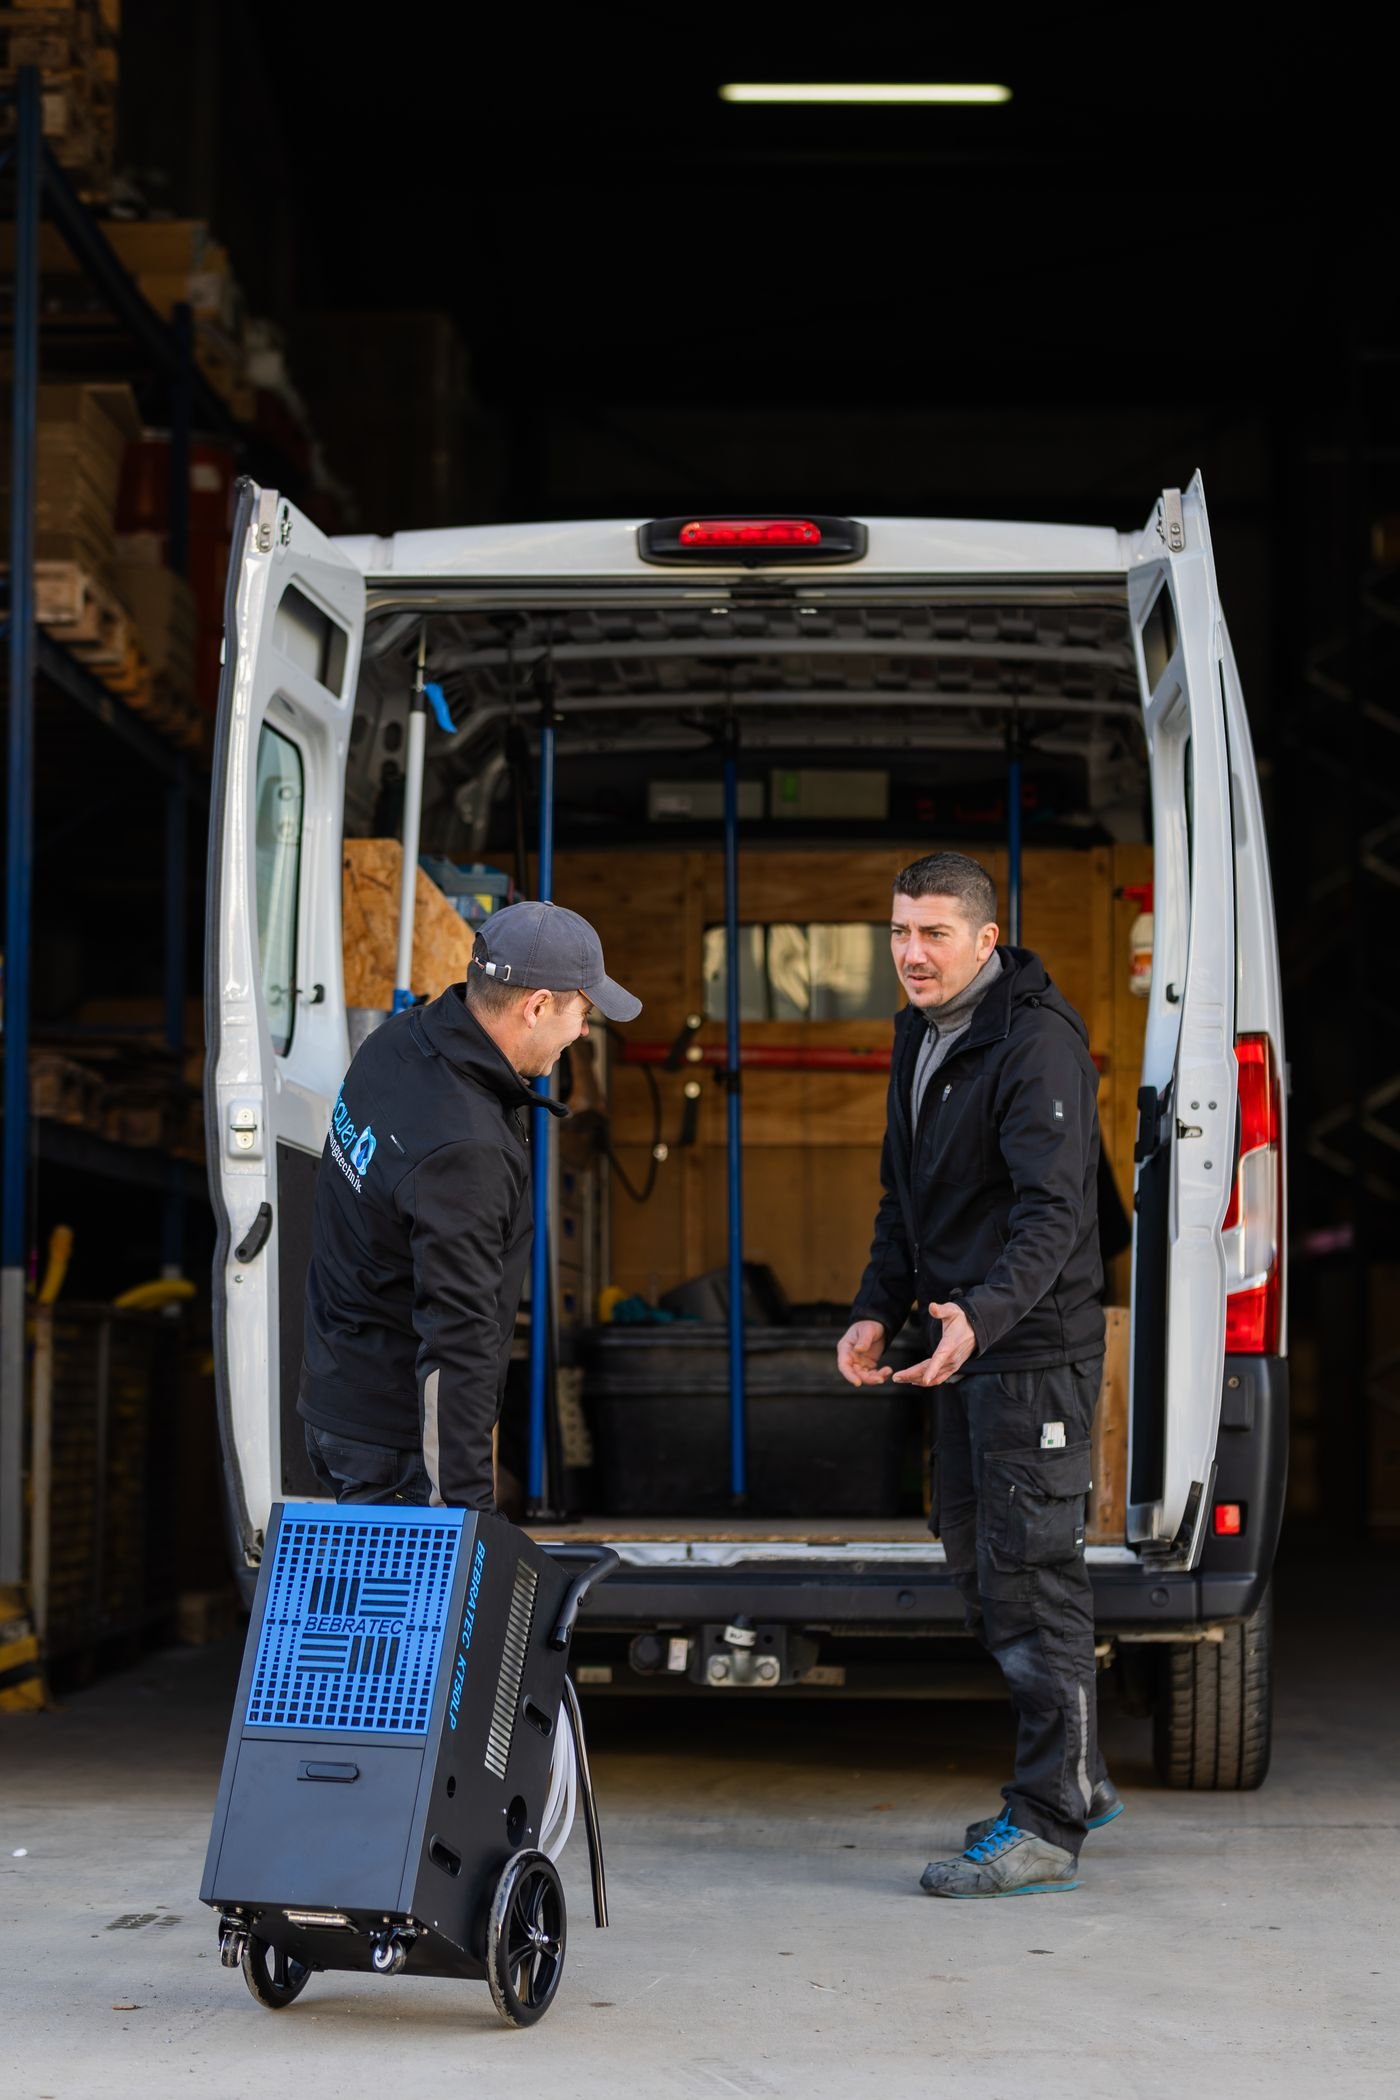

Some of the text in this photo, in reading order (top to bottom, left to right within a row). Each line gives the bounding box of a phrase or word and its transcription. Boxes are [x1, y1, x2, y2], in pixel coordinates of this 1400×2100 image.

[304, 1616, 404, 1635] BEBRATEC
[449, 1539, 486, 1730] BEBRATEC KT50LP
